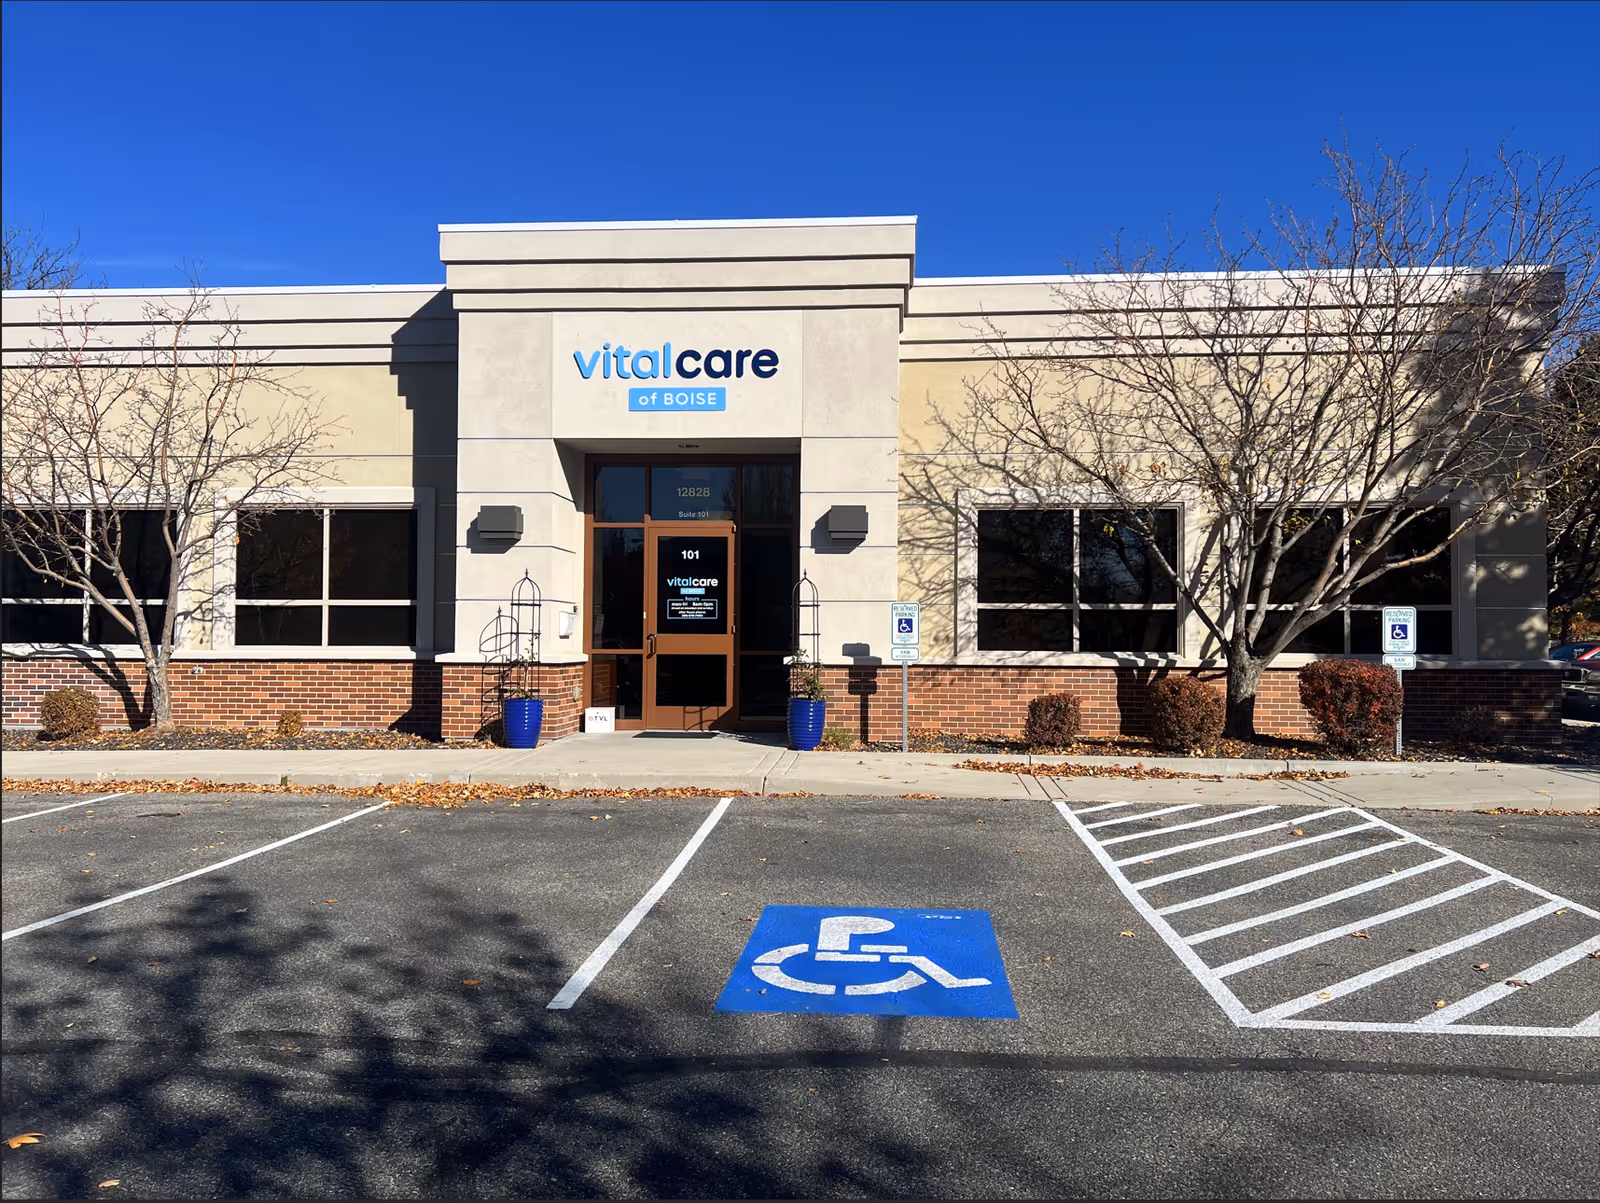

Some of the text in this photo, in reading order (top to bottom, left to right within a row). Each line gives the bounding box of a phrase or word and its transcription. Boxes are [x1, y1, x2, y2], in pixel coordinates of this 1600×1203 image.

[573, 342, 779, 379] vitalcare
[638, 392, 717, 405] of BOISE
[677, 487, 711, 497] 12828
[681, 550, 699, 560] 101
[667, 576, 719, 587] vitalcare
